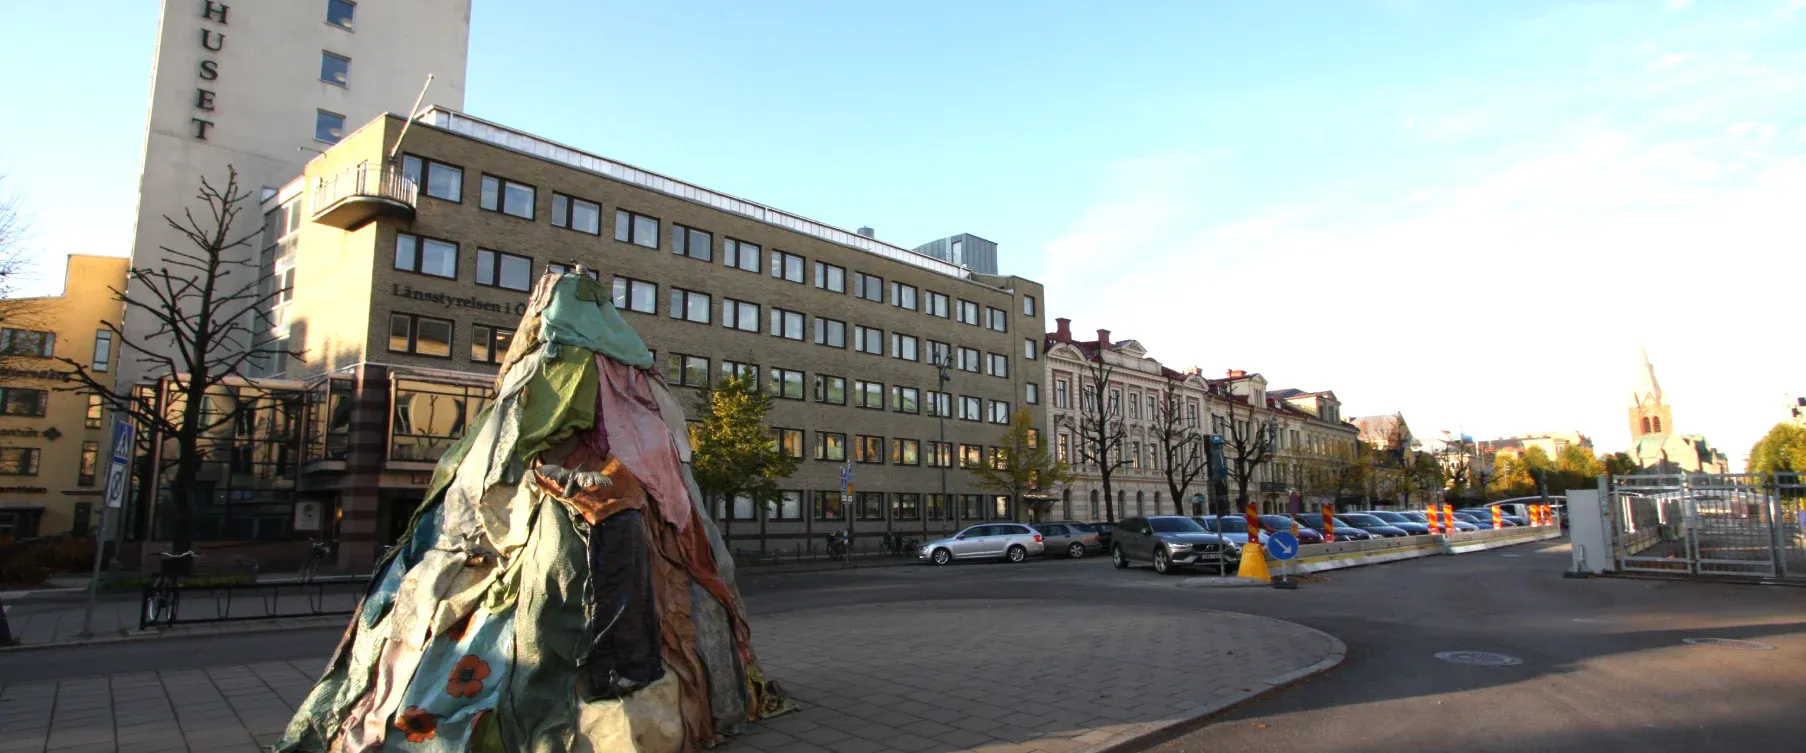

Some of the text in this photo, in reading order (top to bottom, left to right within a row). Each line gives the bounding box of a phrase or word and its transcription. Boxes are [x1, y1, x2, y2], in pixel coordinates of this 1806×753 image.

[192, 0, 230, 140] HUSET
[392, 283, 501, 313] Länsstyrelsen
[505, 301, 511, 315] i
